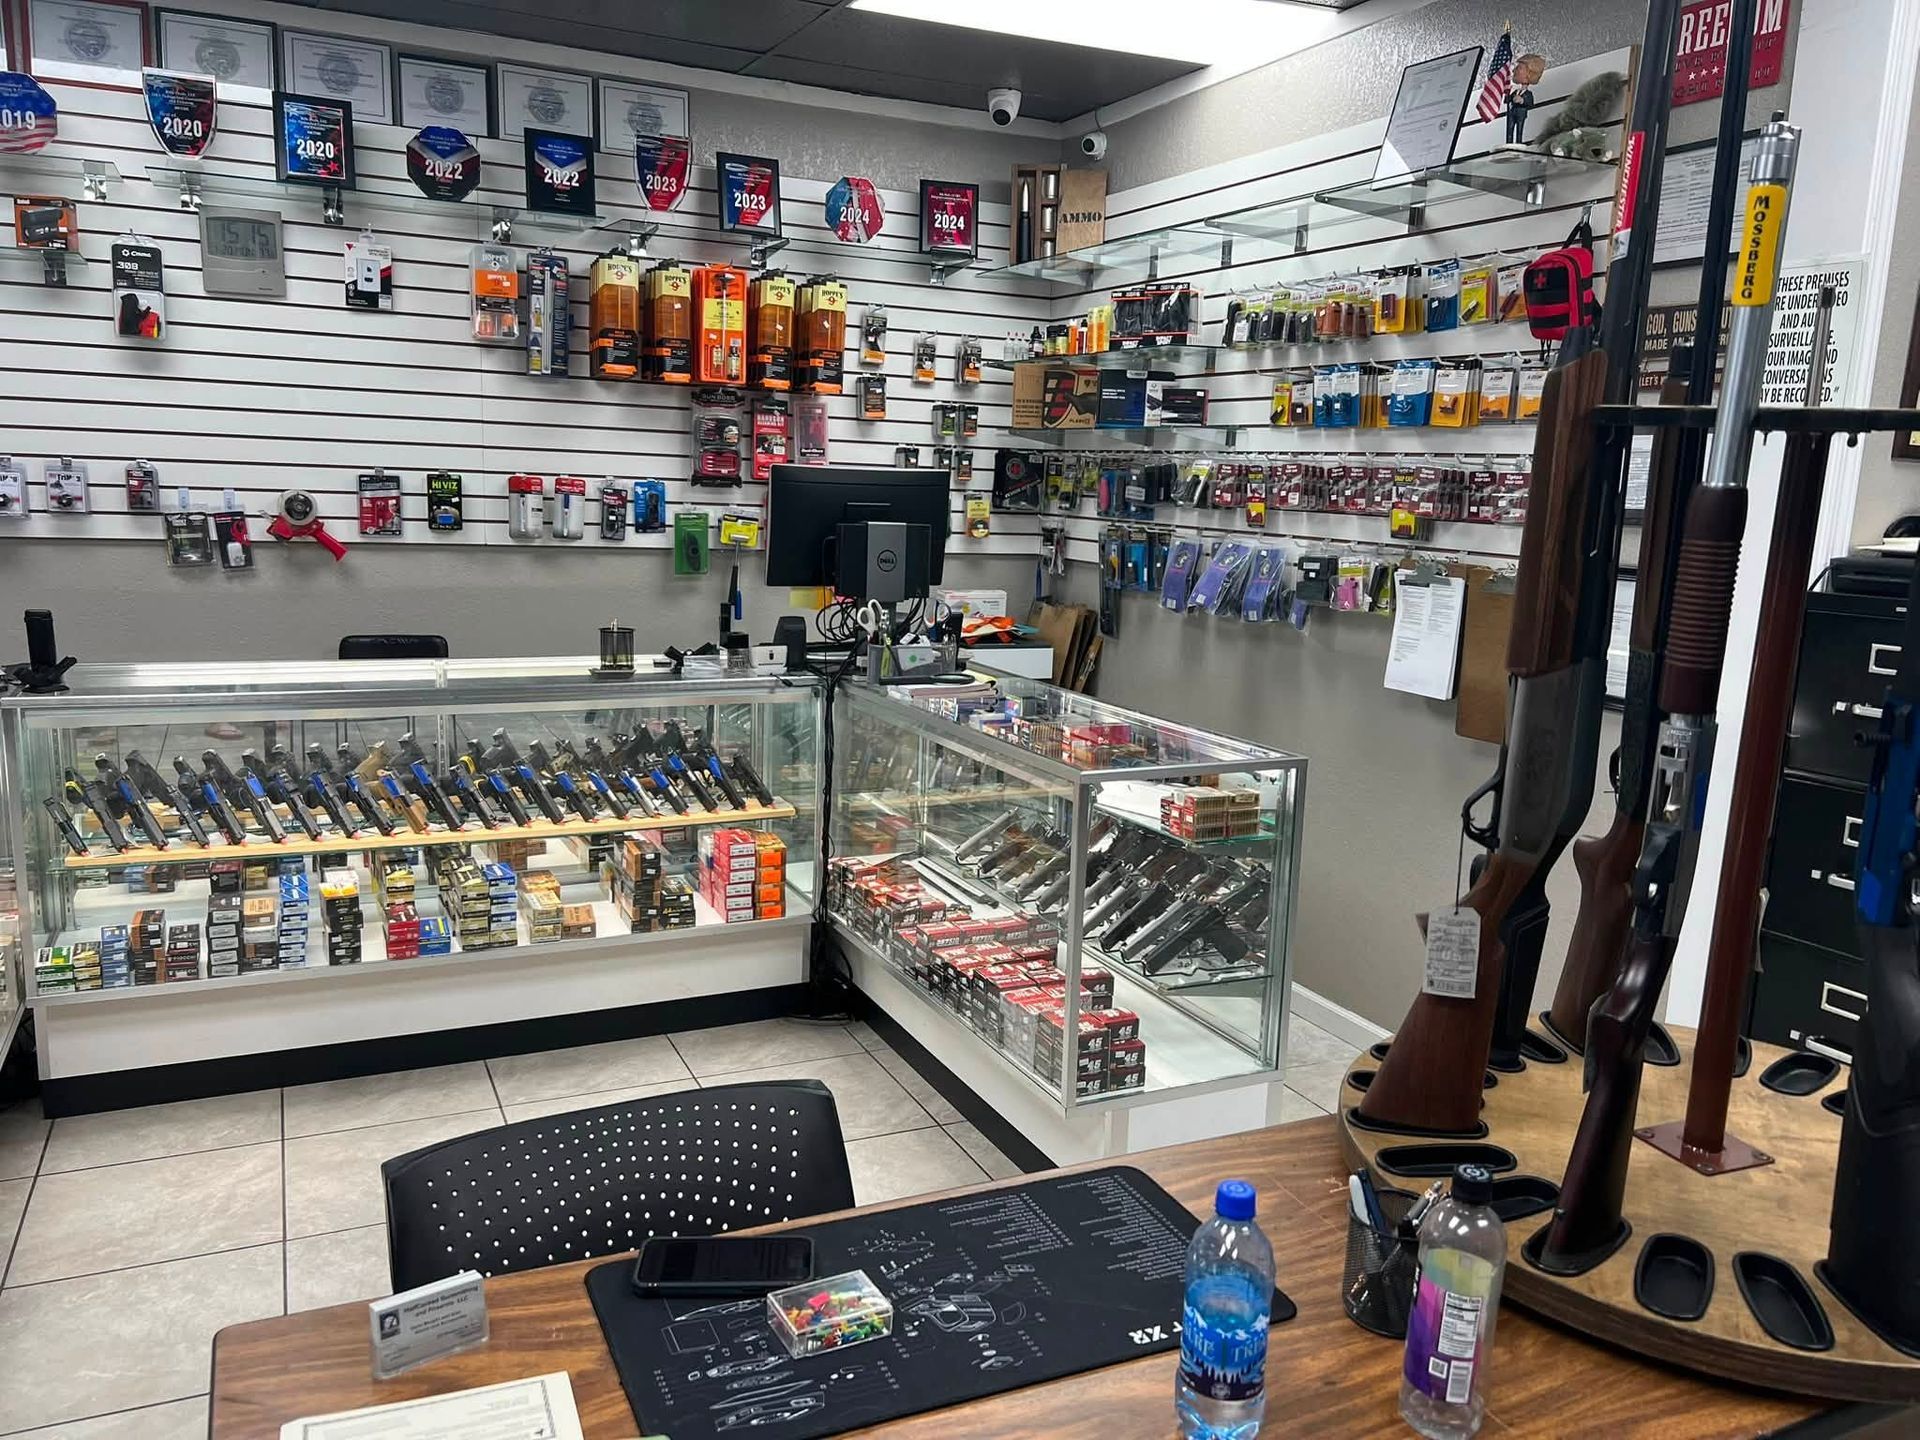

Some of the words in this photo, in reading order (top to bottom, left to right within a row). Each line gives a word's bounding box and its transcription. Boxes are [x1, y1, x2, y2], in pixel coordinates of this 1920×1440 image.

[0, 109, 36, 130] 019
[163, 116, 202, 138] 2020
[297, 138, 335, 159] 2020
[425, 159, 464, 181] 2022
[543, 167, 580, 187] 2022
[646, 174, 677, 192] 2023
[734, 192, 767, 211] 2023
[840, 206, 870, 225] 2024
[934, 213, 966, 231] 2024
[1059, 211, 1103, 224] AMMO
[1741, 195, 1770, 300] MOSSBERG
[615, 270, 625, 281] 9
[1778, 275, 1804, 292] THESE
[1805, 271, 1850, 290] PREMISES
[775, 291, 784, 301] 9
[828, 296, 836, 305] 9
[1775, 295, 1786, 311] RE
[1787, 293, 1818, 310] UNDER
[1646, 313, 1667, 337] GOD,
[1672, 309, 1698, 333] GUNS
[1779, 314, 1800, 329] AND
[1644, 339, 1668, 351] MADE
[1768, 330, 1836, 348] SURVEILLAE.
[1767, 350, 1786, 366] OUR
[1787, 350, 1812, 366] IMAG
[1825, 349, 1838, 365] ND
[1771, 388, 1784, 403] BE
[880, 557, 895, 565] DELL
[1119, 1026, 1133, 1036] 45
[1088, 1038, 1103, 1049] 45
[1087, 1060, 1102, 1071] 45
[1125, 1053, 1139, 1062] 45
[1087, 1080, 1101, 1091] 45
[1125, 1073, 1139, 1083] 45
